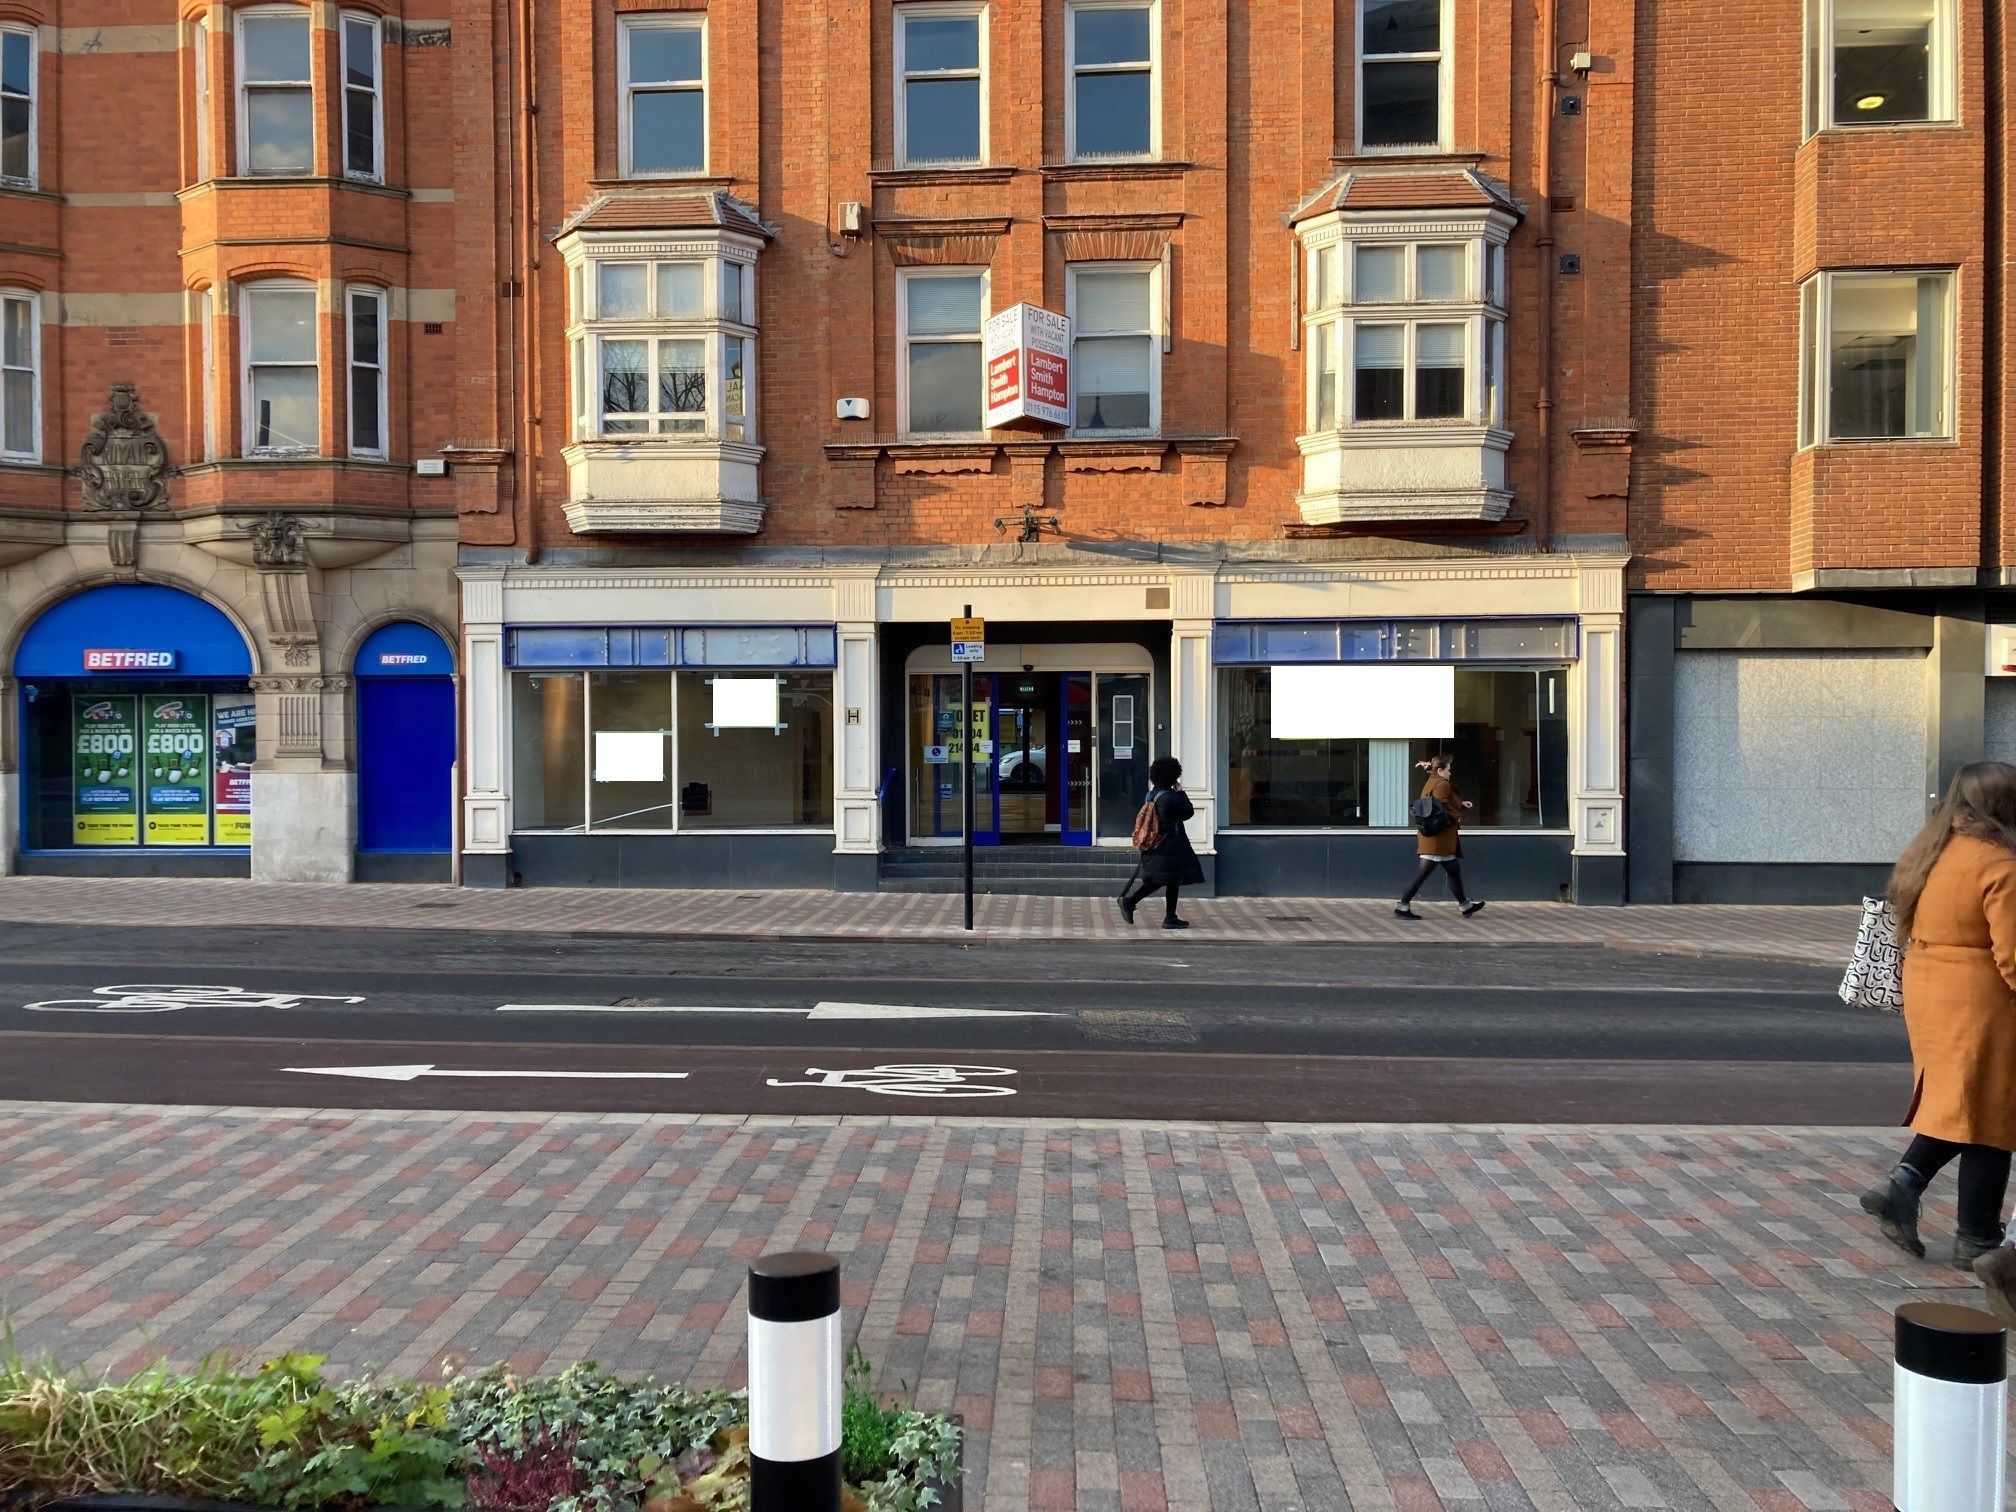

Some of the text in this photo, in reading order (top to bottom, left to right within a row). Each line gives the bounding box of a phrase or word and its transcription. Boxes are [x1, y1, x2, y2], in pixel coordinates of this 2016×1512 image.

[1028, 308, 1066, 331] FOR SALE
[1030, 325, 1064, 343] WITH VACANT
[1031, 337, 1064, 355] POSSESSION
[990, 355, 1016, 375] Lambert
[1030, 353, 1063, 374] Lambert
[990, 372, 1008, 390] Smith
[1030, 368, 1053, 385] Smith
[990, 384, 1018, 404] Hampton
[1030, 382, 1065, 402] Hampton
[1025, 402, 1041, 415] 0115
[88, 653, 172, 667] BETFRED
[381, 655, 428, 664] BETFRED
[216, 711, 229, 719] WE
[230, 709, 246, 718] ARE
[848, 710, 859, 723] H
[77, 734, 133, 753] £800
[147, 734, 204, 753] £800
